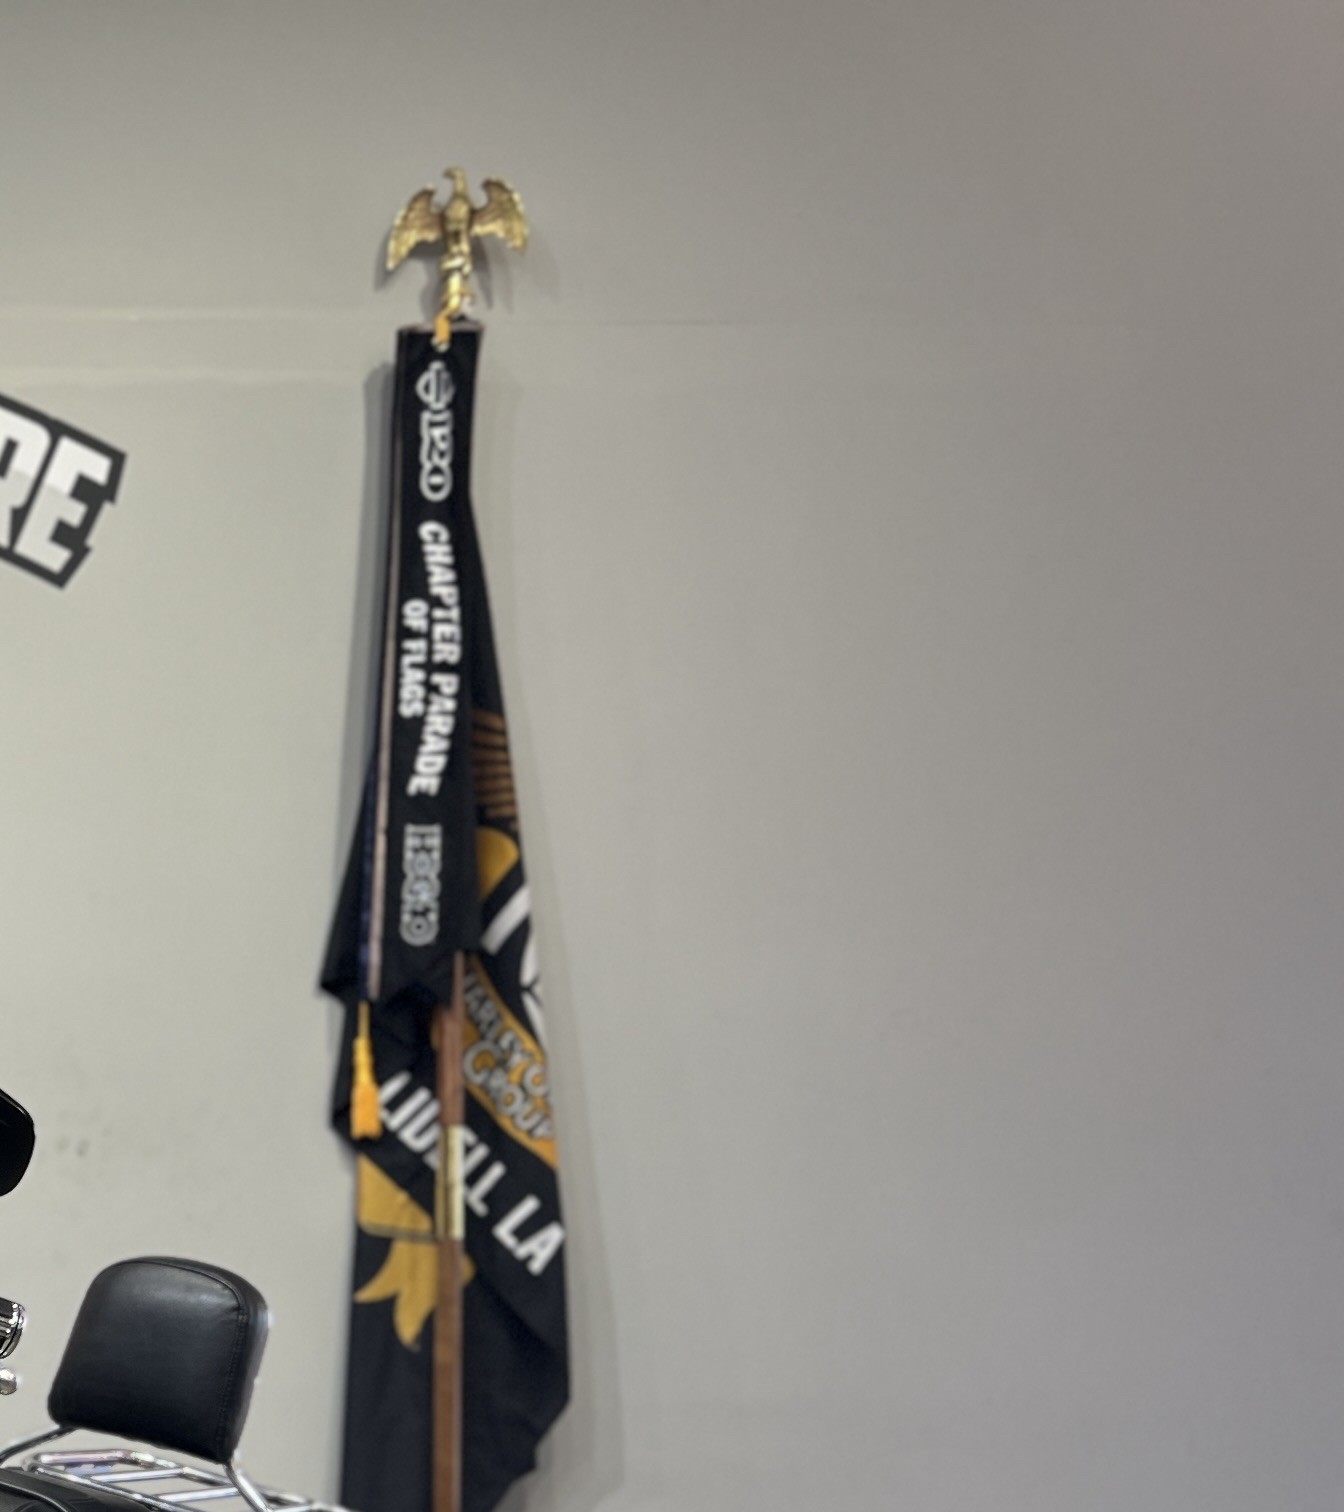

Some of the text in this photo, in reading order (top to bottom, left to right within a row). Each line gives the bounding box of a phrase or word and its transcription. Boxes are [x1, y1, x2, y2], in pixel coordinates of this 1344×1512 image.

[398, 599, 429, 718] OF FLAGS
[406, 521, 461, 796] CHAPTER PARADE
[492, 1194, 565, 1275] LA
